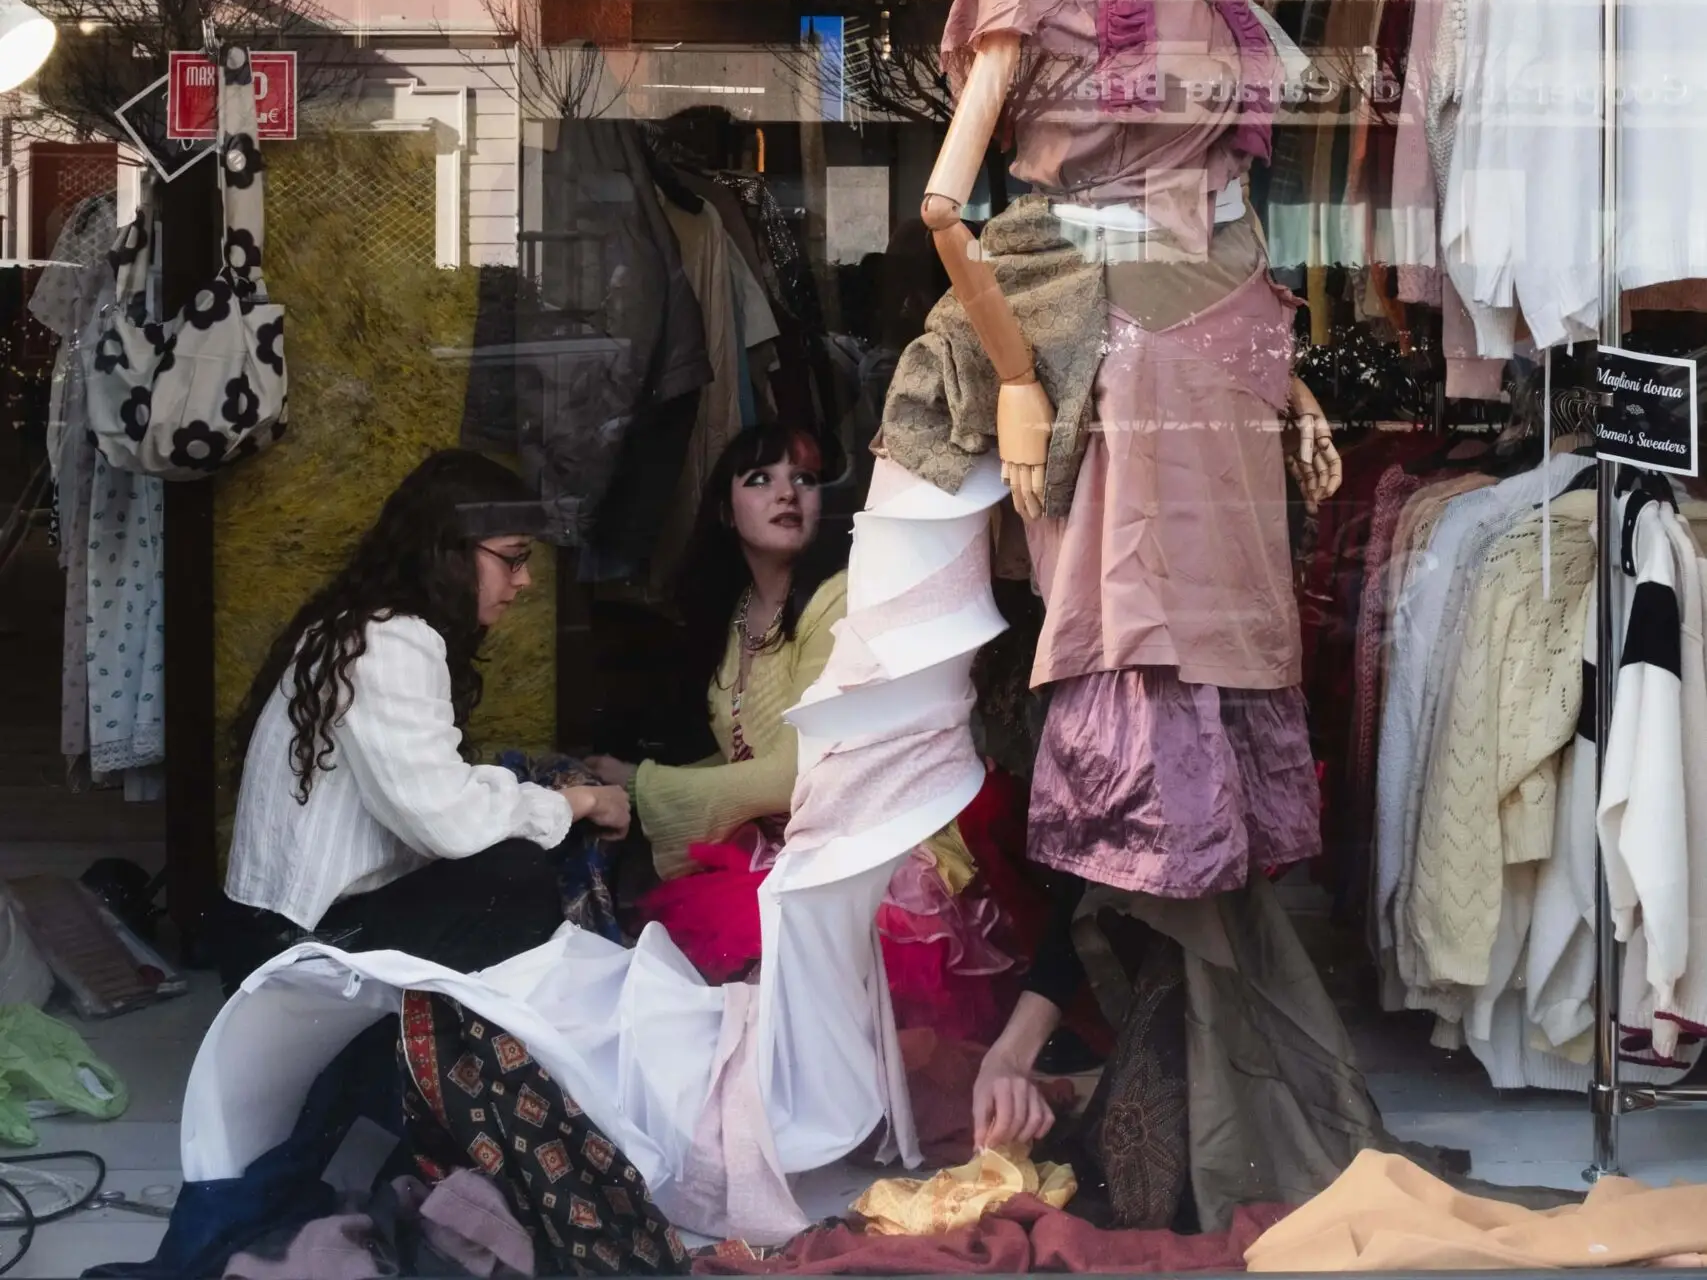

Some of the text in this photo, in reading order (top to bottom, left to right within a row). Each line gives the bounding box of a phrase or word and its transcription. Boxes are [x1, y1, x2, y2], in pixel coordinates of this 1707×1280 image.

[185, 66, 216, 86] MAX
[1596, 366, 1684, 399] Maglioni donna
[1636, 431, 1688, 455] Sweaters
